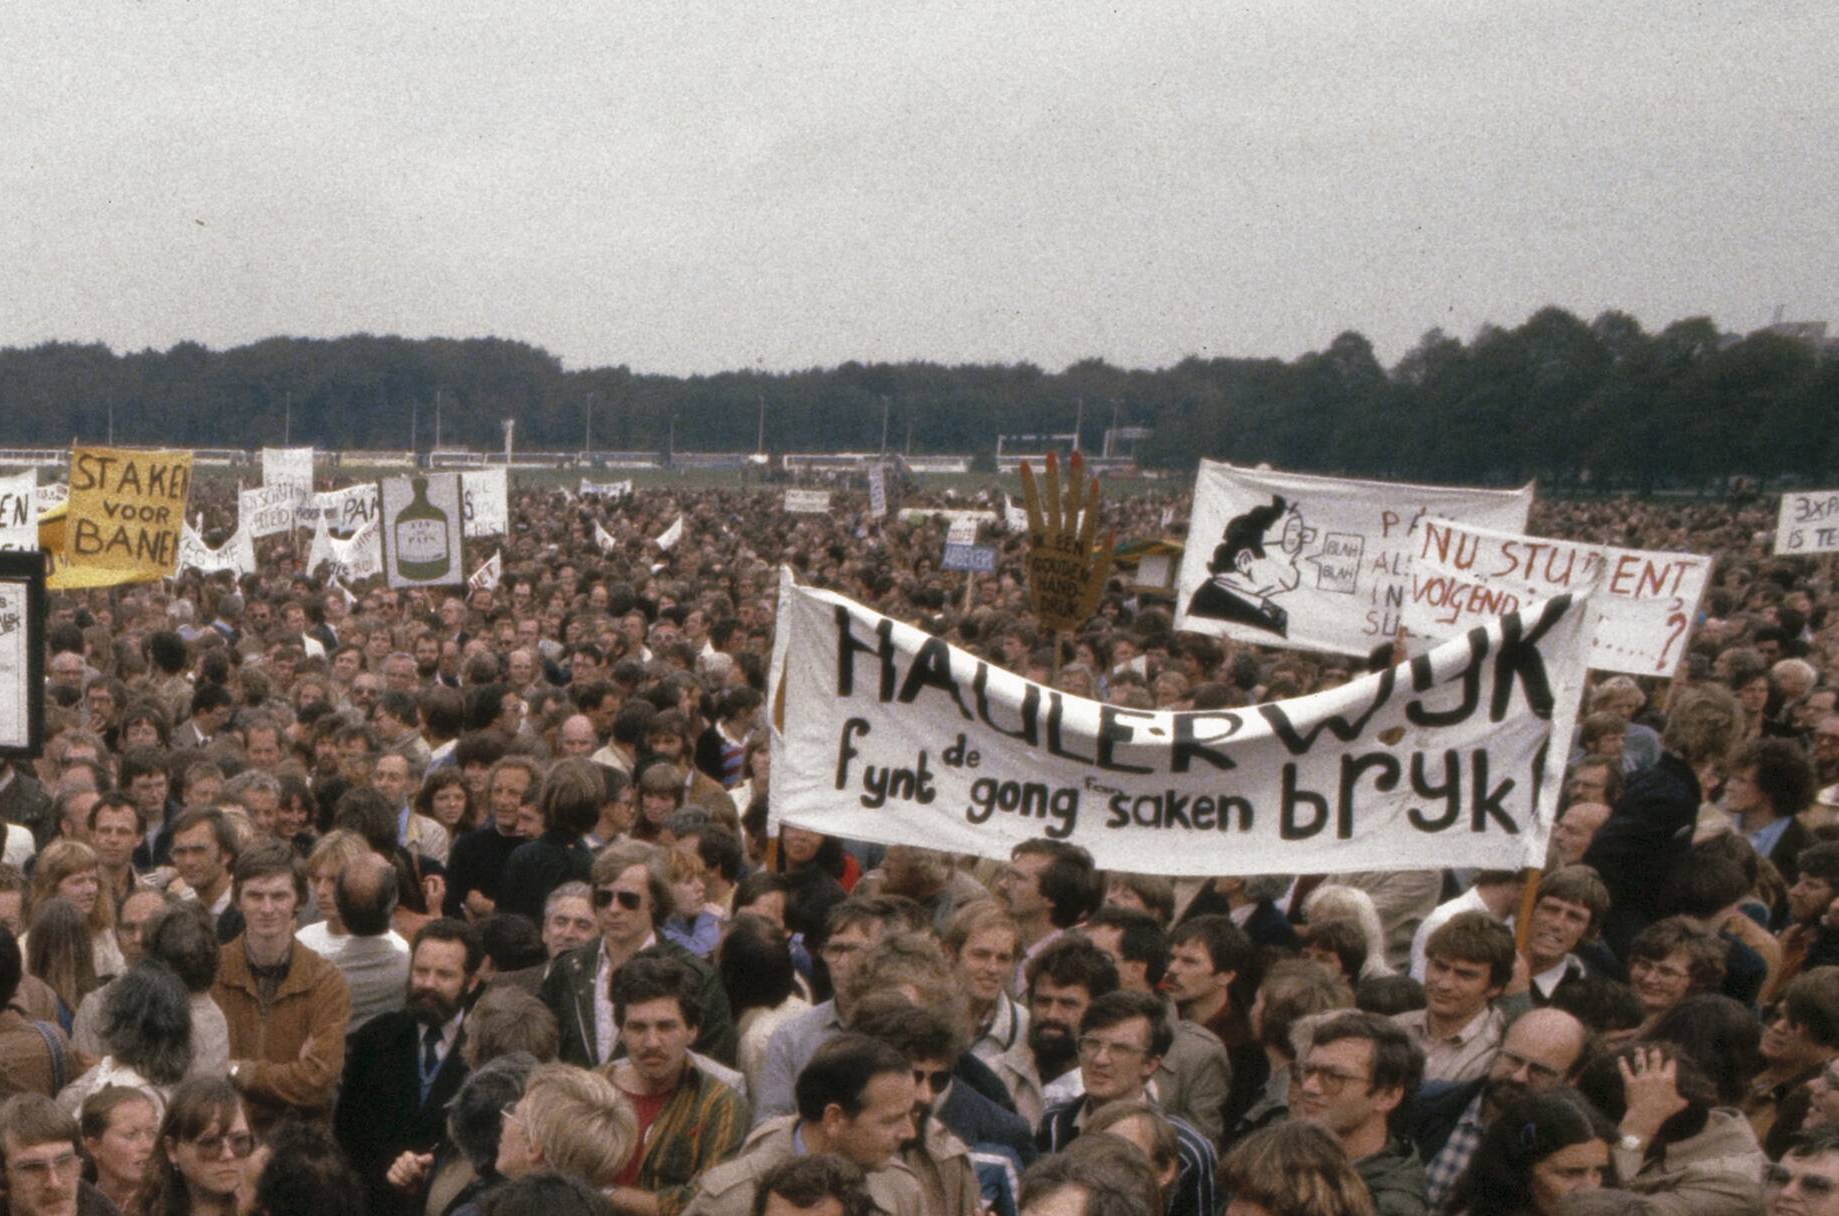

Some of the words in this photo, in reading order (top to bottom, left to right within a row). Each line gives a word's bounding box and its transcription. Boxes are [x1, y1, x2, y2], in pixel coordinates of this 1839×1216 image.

[104, 500, 170, 525] VOOR
[1326, 540, 1357, 557] BLAH
[1421, 521, 1480, 570] NU
[1322, 566, 1354, 581] BLAH
[835, 717, 936, 808] fynt
[942, 733, 981, 768] de
[966, 777, 1079, 839] gong
[1106, 789, 1254, 832] saken
